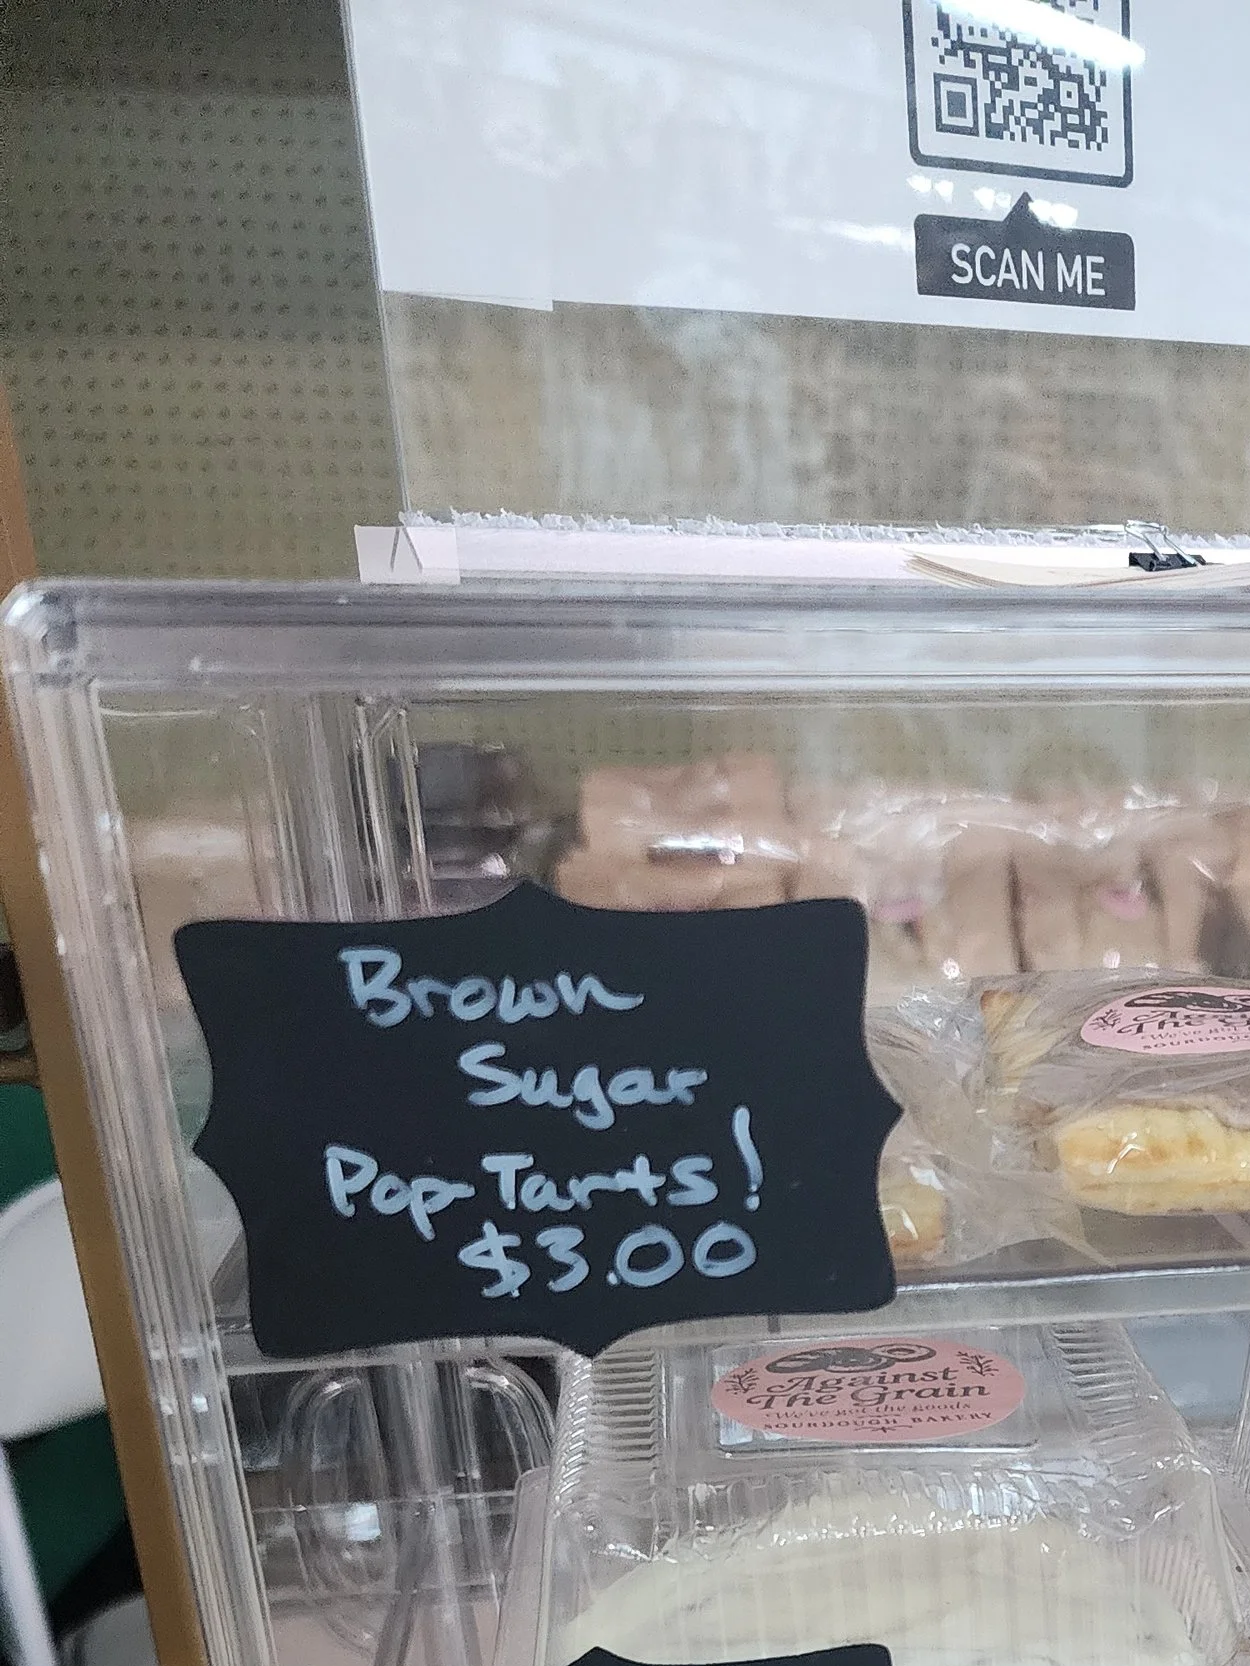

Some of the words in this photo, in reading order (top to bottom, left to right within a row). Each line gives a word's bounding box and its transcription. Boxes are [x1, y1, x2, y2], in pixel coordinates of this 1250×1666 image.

[951, 243, 1044, 291] SCAN
[1057, 252, 1105, 295] ME
[339, 946, 644, 1028] Brown
[457, 1042, 708, 1129] Sugar
[457, 1221, 758, 1298] $3.00
[746, 1391, 836, 1411] The
[850, 1382, 991, 1407] Grain
[766, 1366, 960, 1394] Against
[764, 1417, 898, 1430] SOURDOUGH
[911, 1412, 993, 1424] BAKERY
